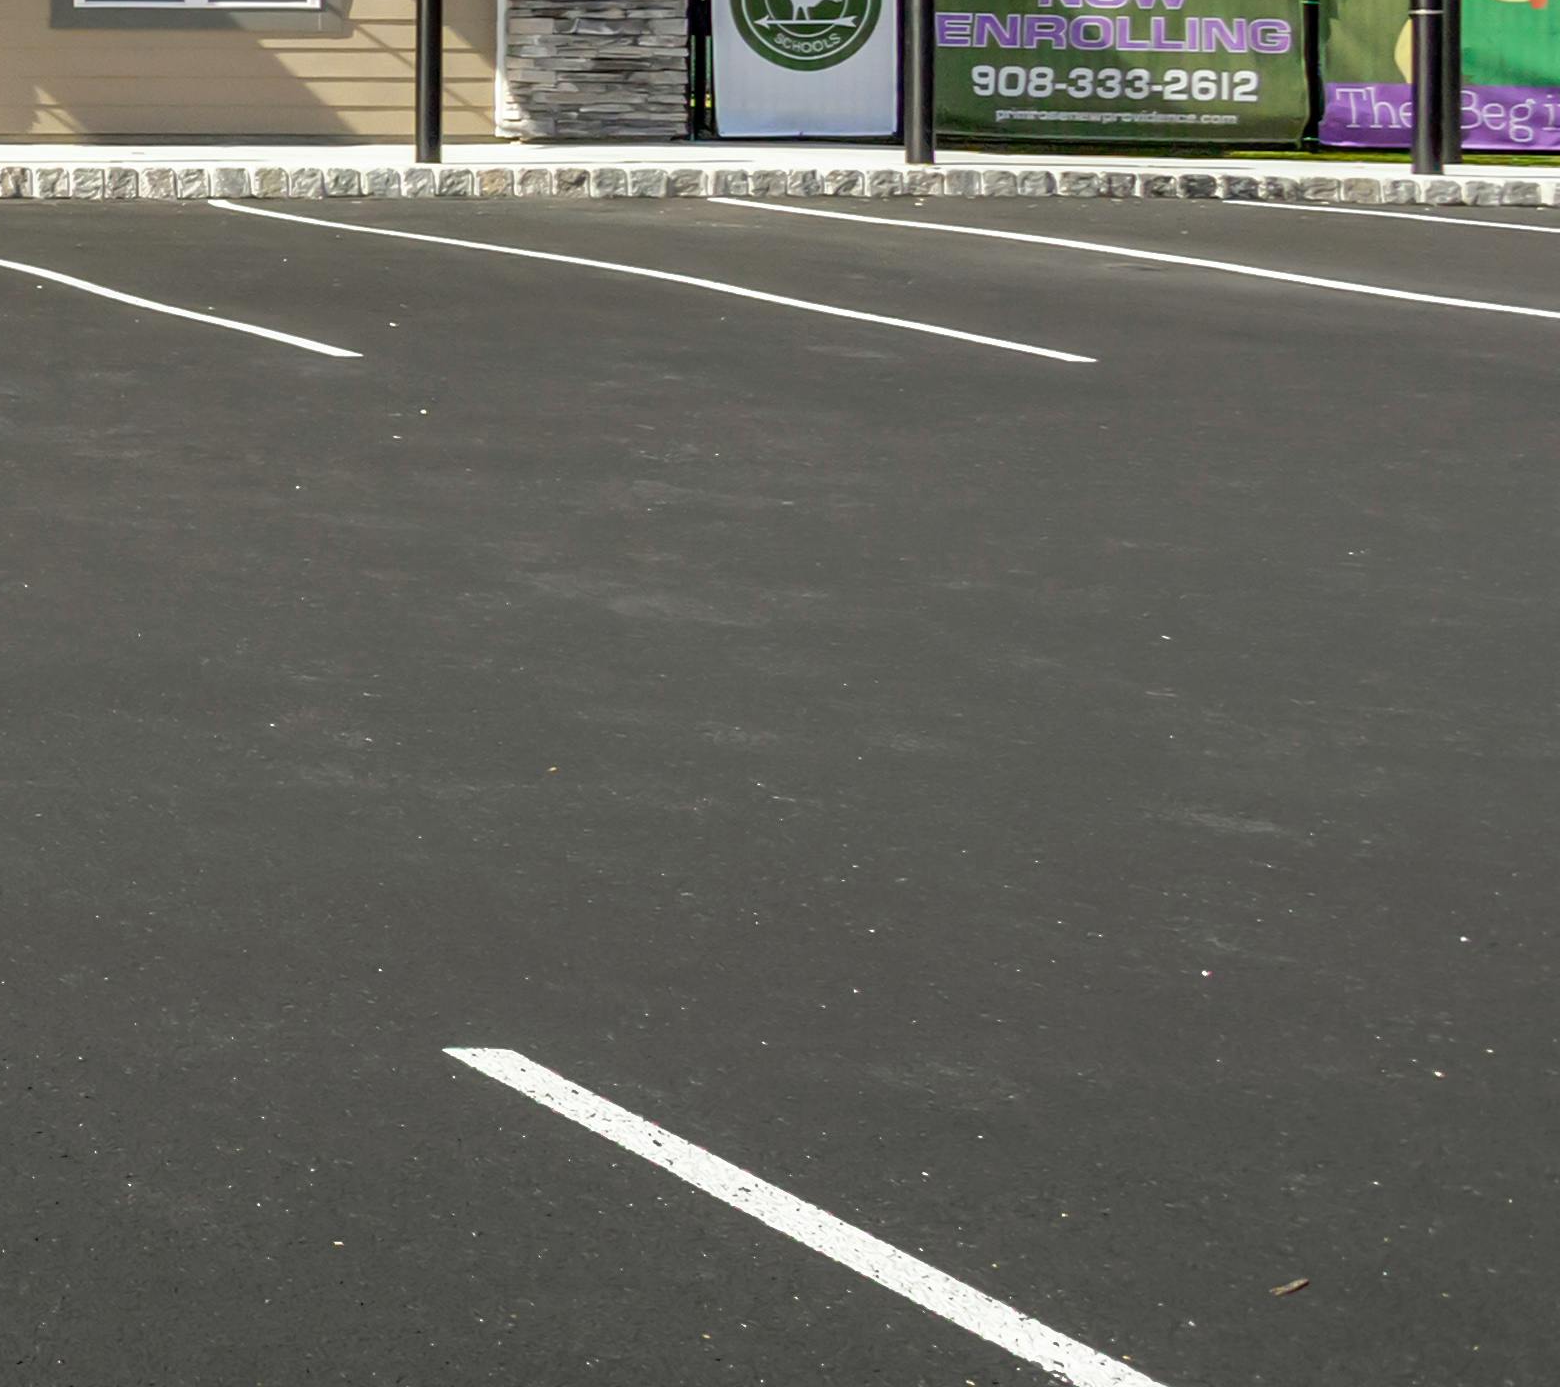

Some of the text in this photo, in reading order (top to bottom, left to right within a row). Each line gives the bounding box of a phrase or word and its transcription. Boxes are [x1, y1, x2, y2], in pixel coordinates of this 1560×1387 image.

[774, 32, 841, 53] SCHOOLS
[935, 12, 1292, 54] ENROLLING
[971, 65, 1259, 102] 908-333-2612
[995, 108, 1238, 124] primrosenewprovidence.com
